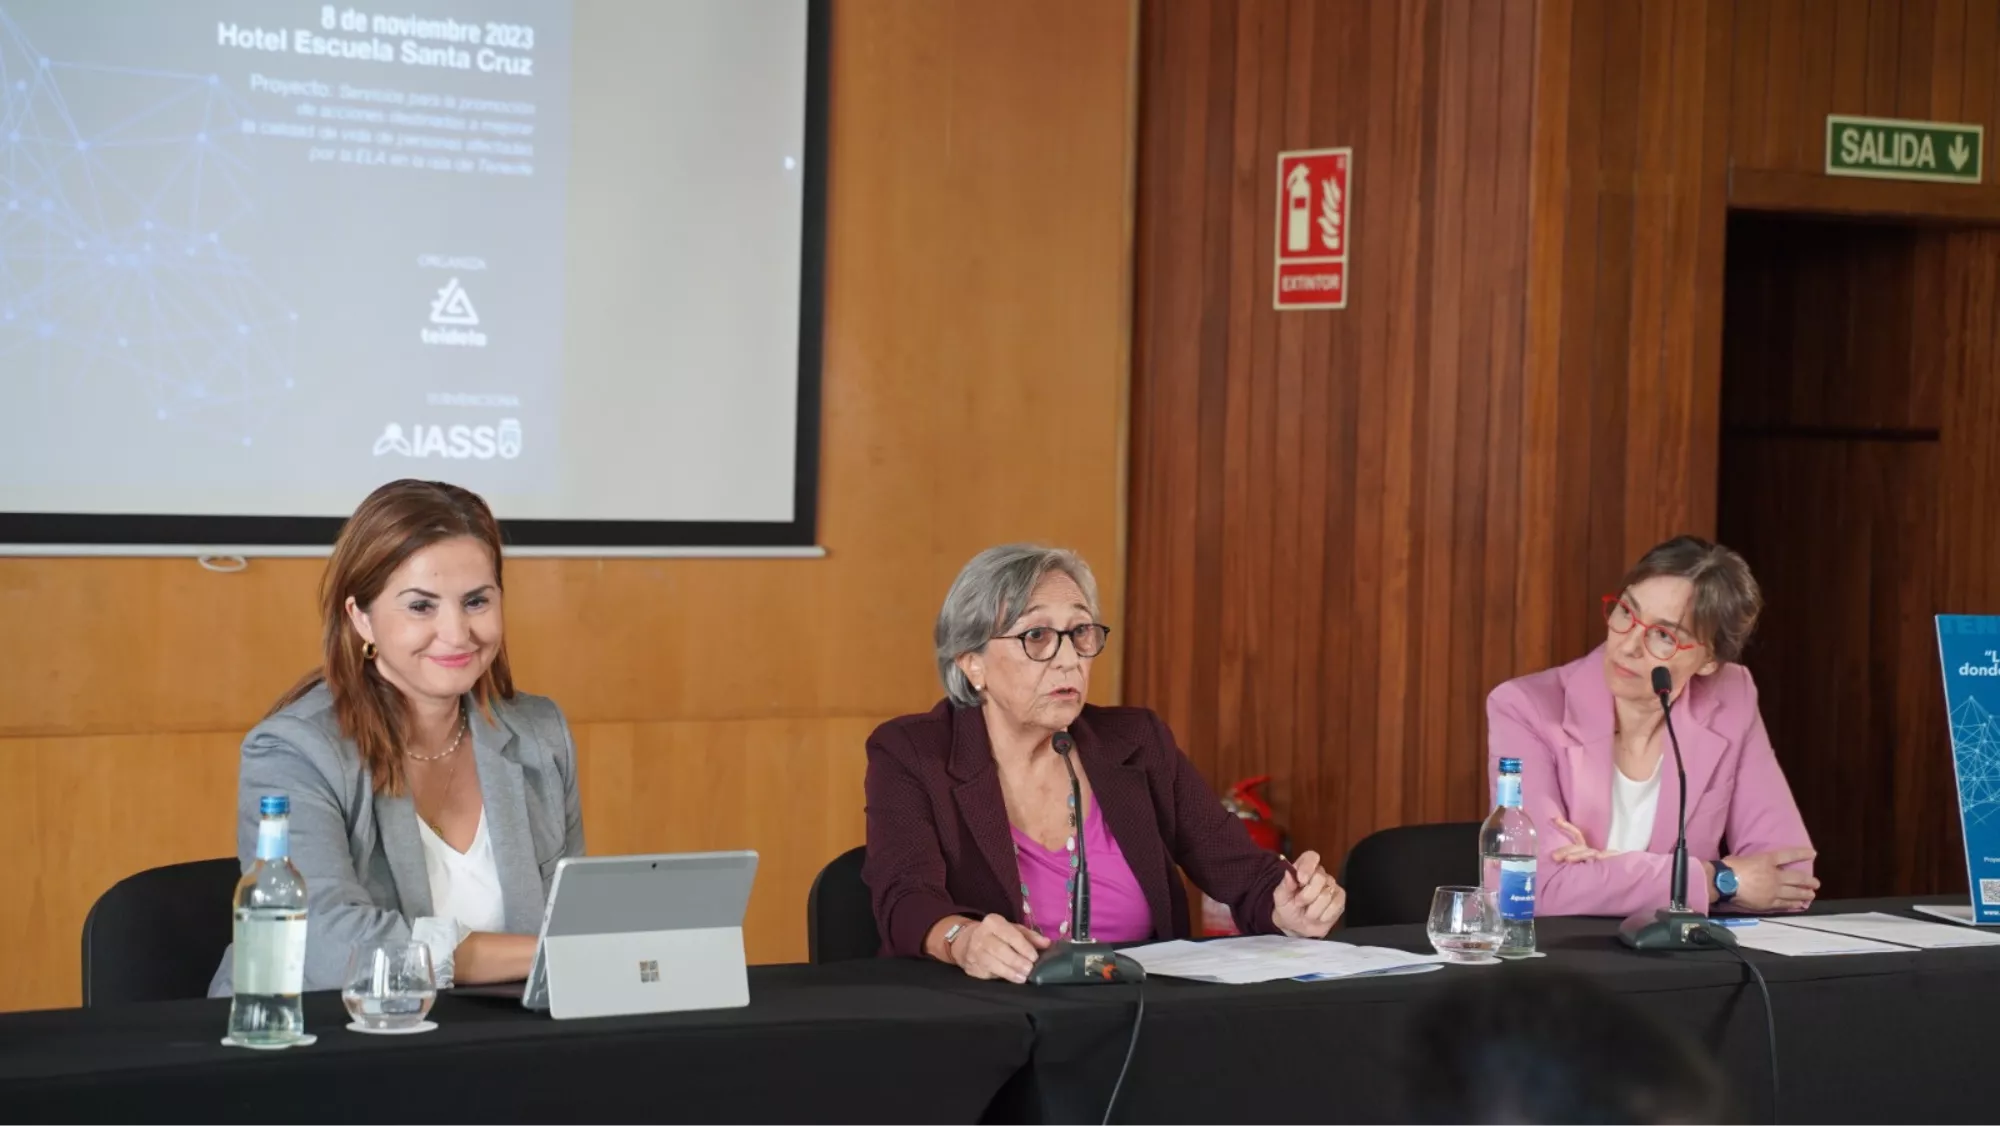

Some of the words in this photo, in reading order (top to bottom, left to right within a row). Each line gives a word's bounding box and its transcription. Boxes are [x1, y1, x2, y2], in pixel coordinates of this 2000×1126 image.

[321, 4, 336, 30] 8
[341, 8, 368, 33] de
[373, 13, 480, 44] noviembre
[485, 22, 535, 50] 2023
[218, 22, 287, 52] Hotel
[294, 29, 394, 62] Escuela
[401, 39, 471, 70] Santa
[477, 48, 534, 76] Cruz
[250, 72, 332, 98] Proyecto:
[1840, 127, 1936, 168] SALIDA
[1281, 274, 1340, 292] EXTINTOR
[413, 424, 497, 459] IASS
